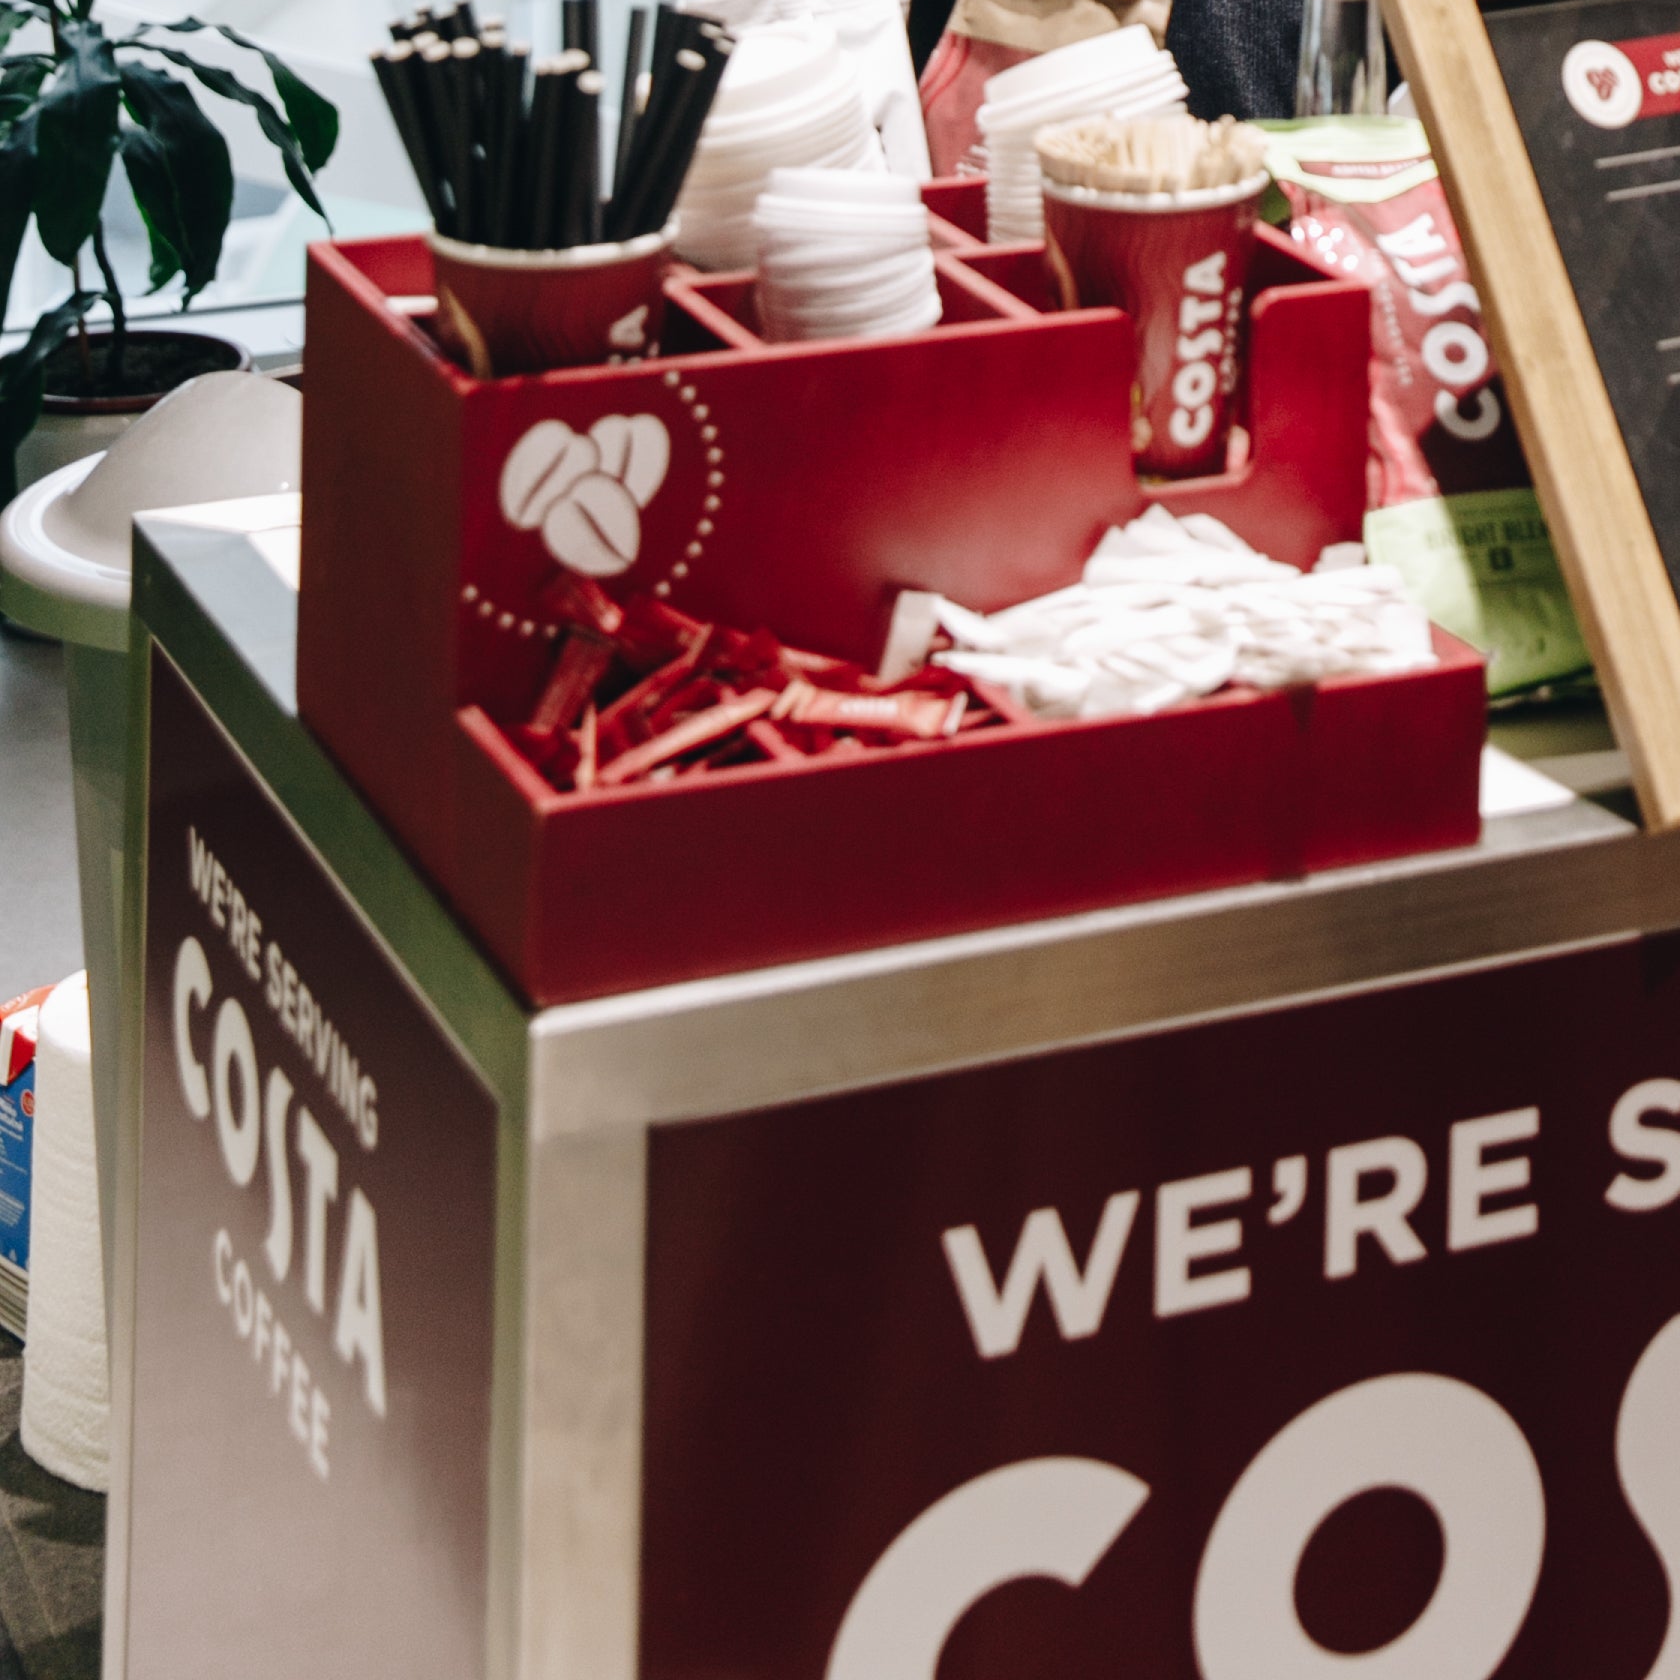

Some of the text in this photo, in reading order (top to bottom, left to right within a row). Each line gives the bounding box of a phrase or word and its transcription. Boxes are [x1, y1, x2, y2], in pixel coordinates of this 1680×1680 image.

[1169, 251, 1227, 448] COSTA
[189, 825, 379, 1152] WE'RE SERVING
[173, 935, 387, 1418] COSTA
[942, 1106, 1541, 1359] WE'RE
[214, 1227, 331, 1480] COFFEE
